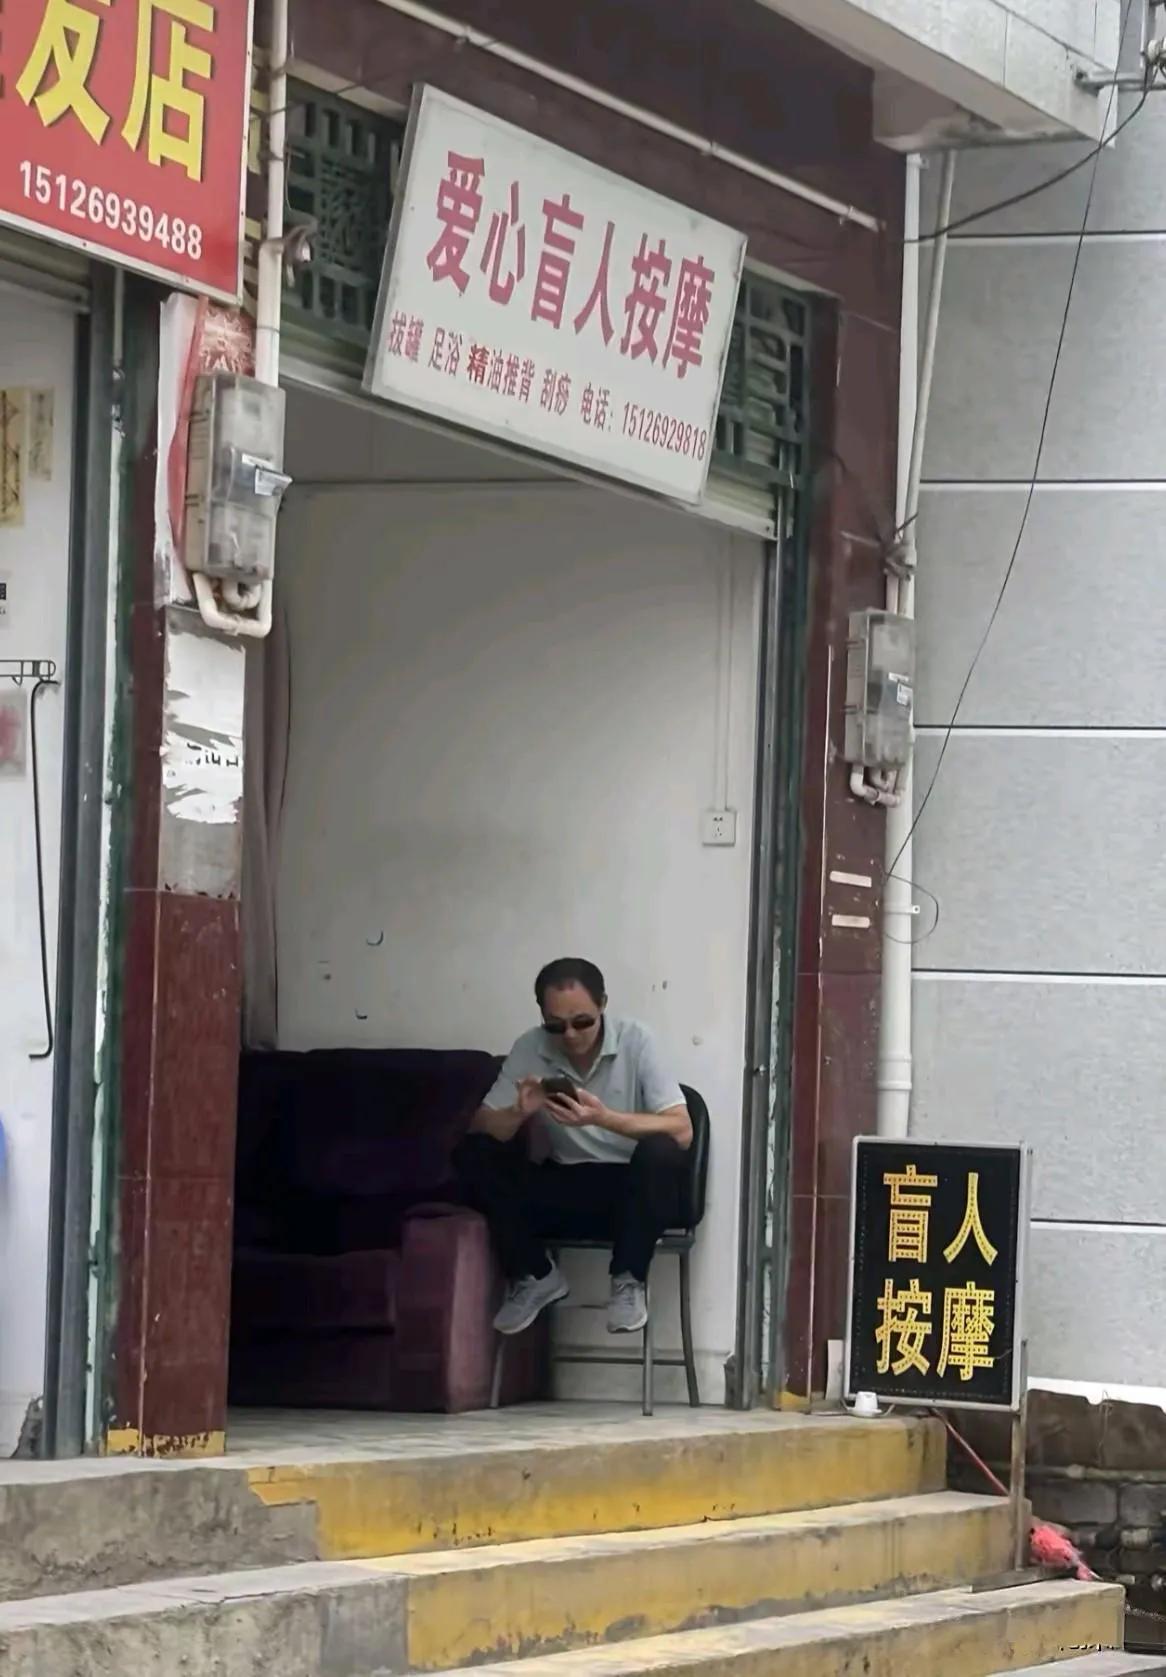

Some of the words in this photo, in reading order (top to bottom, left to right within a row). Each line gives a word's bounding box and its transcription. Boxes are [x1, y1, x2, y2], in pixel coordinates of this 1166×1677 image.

[20, 160, 202, 260] 15126939488
[426, 150, 715, 379] 爱心盲人按摩
[428, 326, 463, 376] 足浴
[466, 343, 535, 404] 精油推背
[540, 368, 571, 416] 刮痧
[623, 401, 707, 461] 15126929818
[883, 1164, 998, 1266] 盲人
[875, 1278, 995, 1381] 按摩
